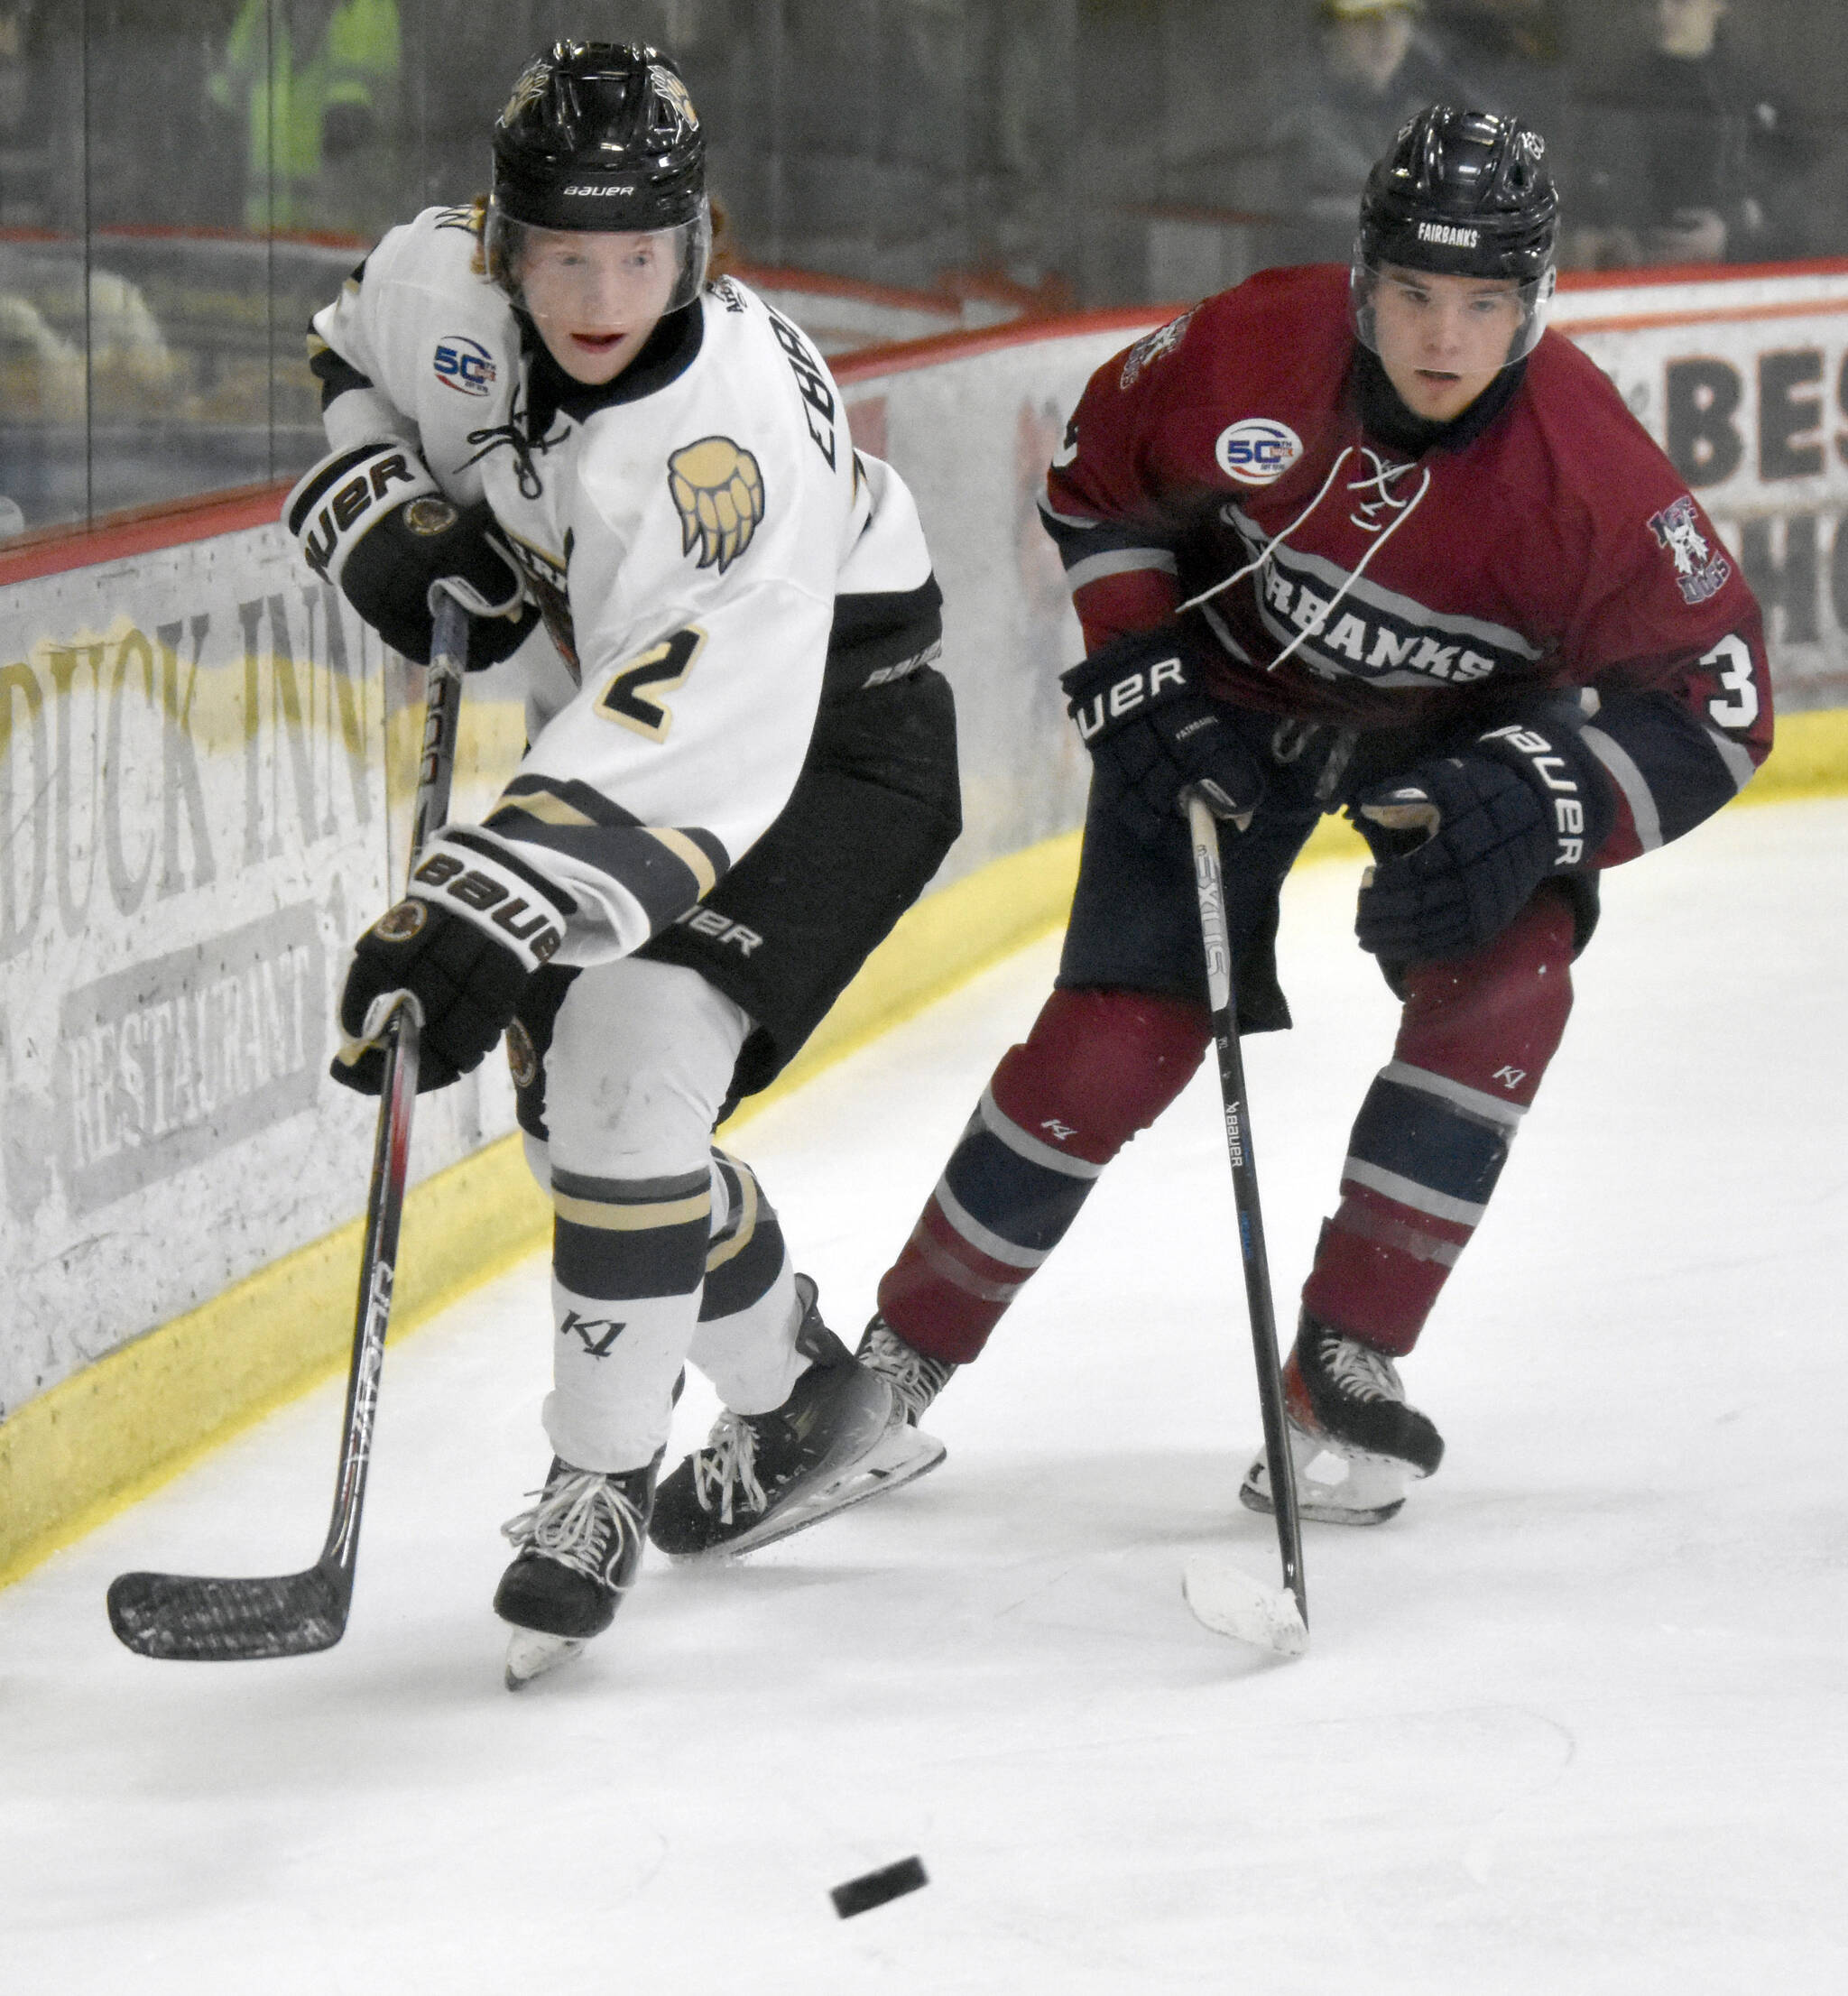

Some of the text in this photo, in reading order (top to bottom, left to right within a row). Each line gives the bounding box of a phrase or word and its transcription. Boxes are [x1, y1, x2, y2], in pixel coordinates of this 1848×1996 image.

[1418, 223, 1477, 247] FAIRBANKS
[1664, 349, 1848, 490] BE
[305, 454, 416, 585] UER
[594, 624, 708, 744] 2
[1264, 559, 1495, 682] RBANKS
[1700, 633, 1759, 727] 3
[1072, 657, 1187, 741] UER
[0, 582, 374, 962] DUCK INN
[1479, 725, 1585, 866] AUER
[69, 946, 311, 1169] RESTAURANT
